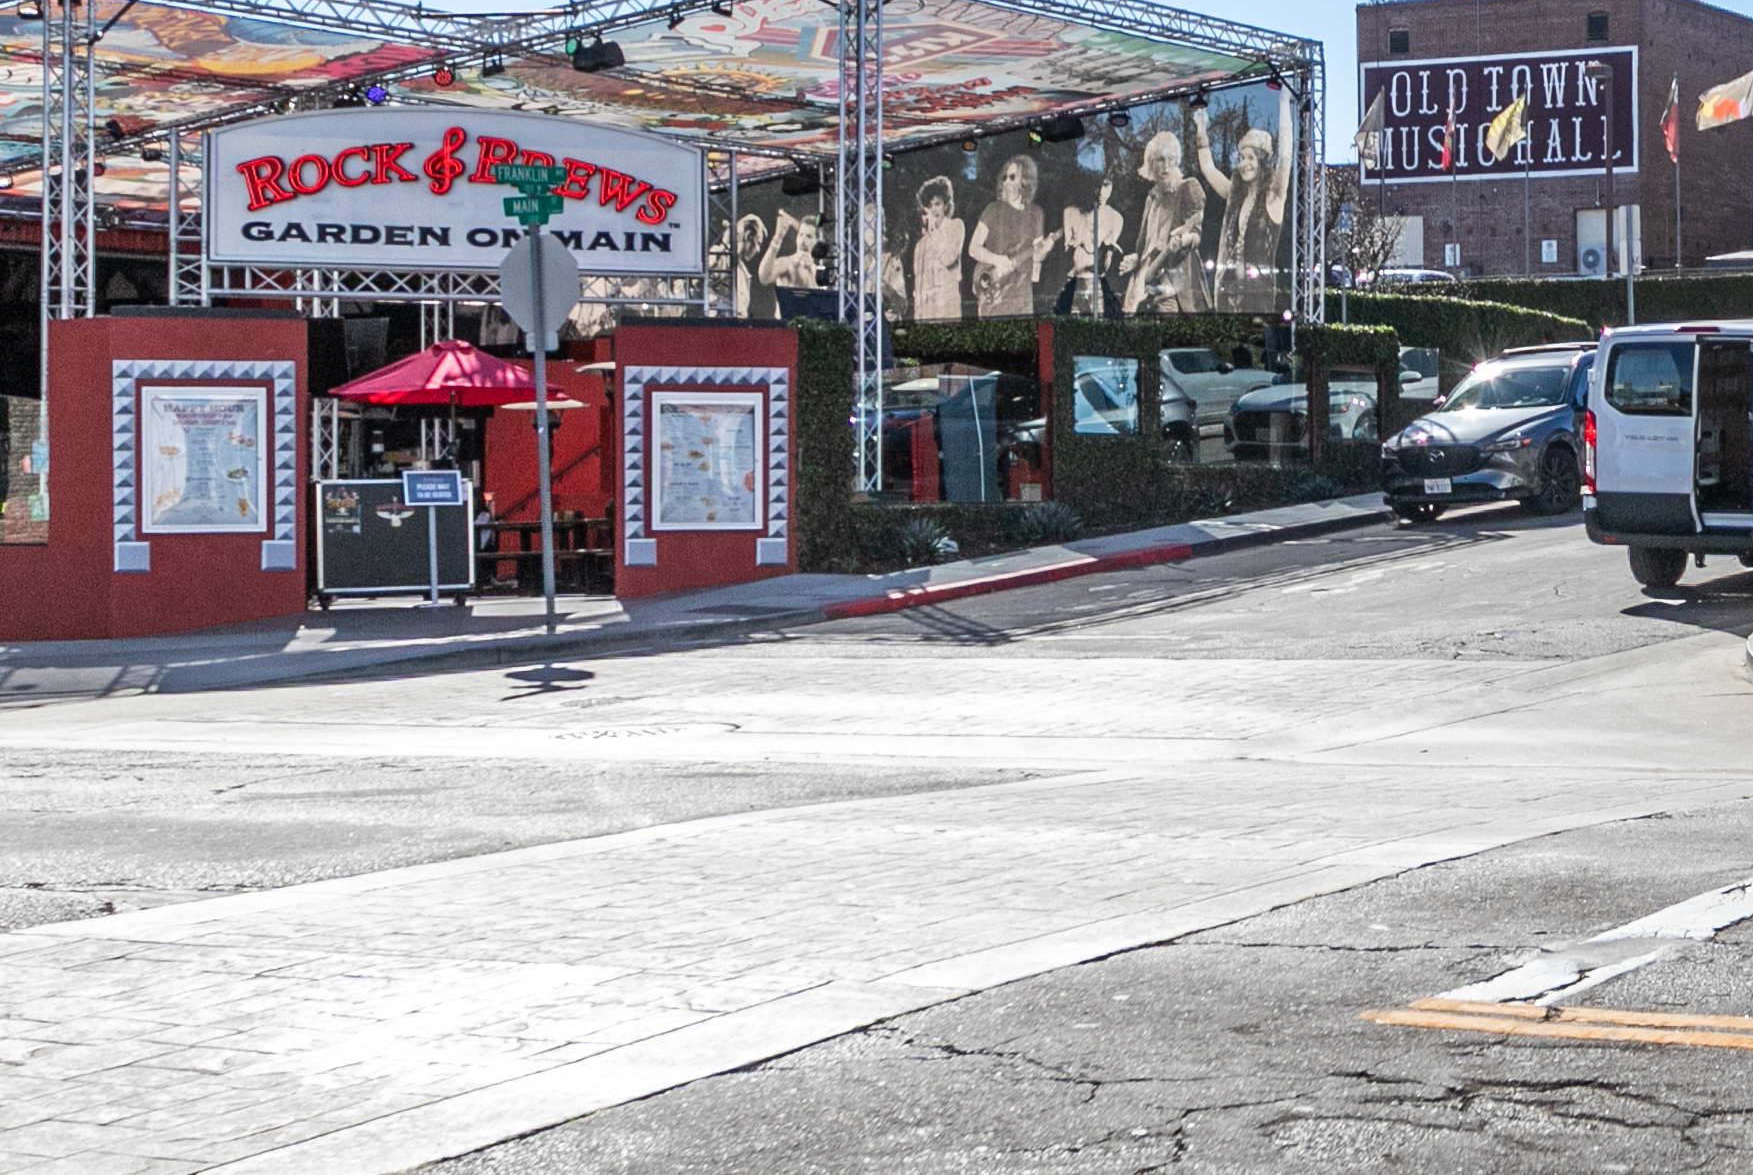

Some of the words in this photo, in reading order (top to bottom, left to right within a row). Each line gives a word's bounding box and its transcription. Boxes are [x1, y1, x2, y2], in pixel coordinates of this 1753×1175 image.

[1390, 69, 1468, 117] OLD
[1483, 60, 1599, 113] TOWN
[1374, 122, 1496, 171] MUSIC
[1514, 115, 1621, 165] HALL
[236, 141, 418, 213] ROCK
[498, 166, 548, 182] FRANKLIN
[513, 199, 539, 214] MAIN
[240, 221, 451, 247] GARDEN
[549, 230, 672, 254] MAIN
[163, 404, 205, 413] HAPPY
[209, 404, 245, 413] HOUR
